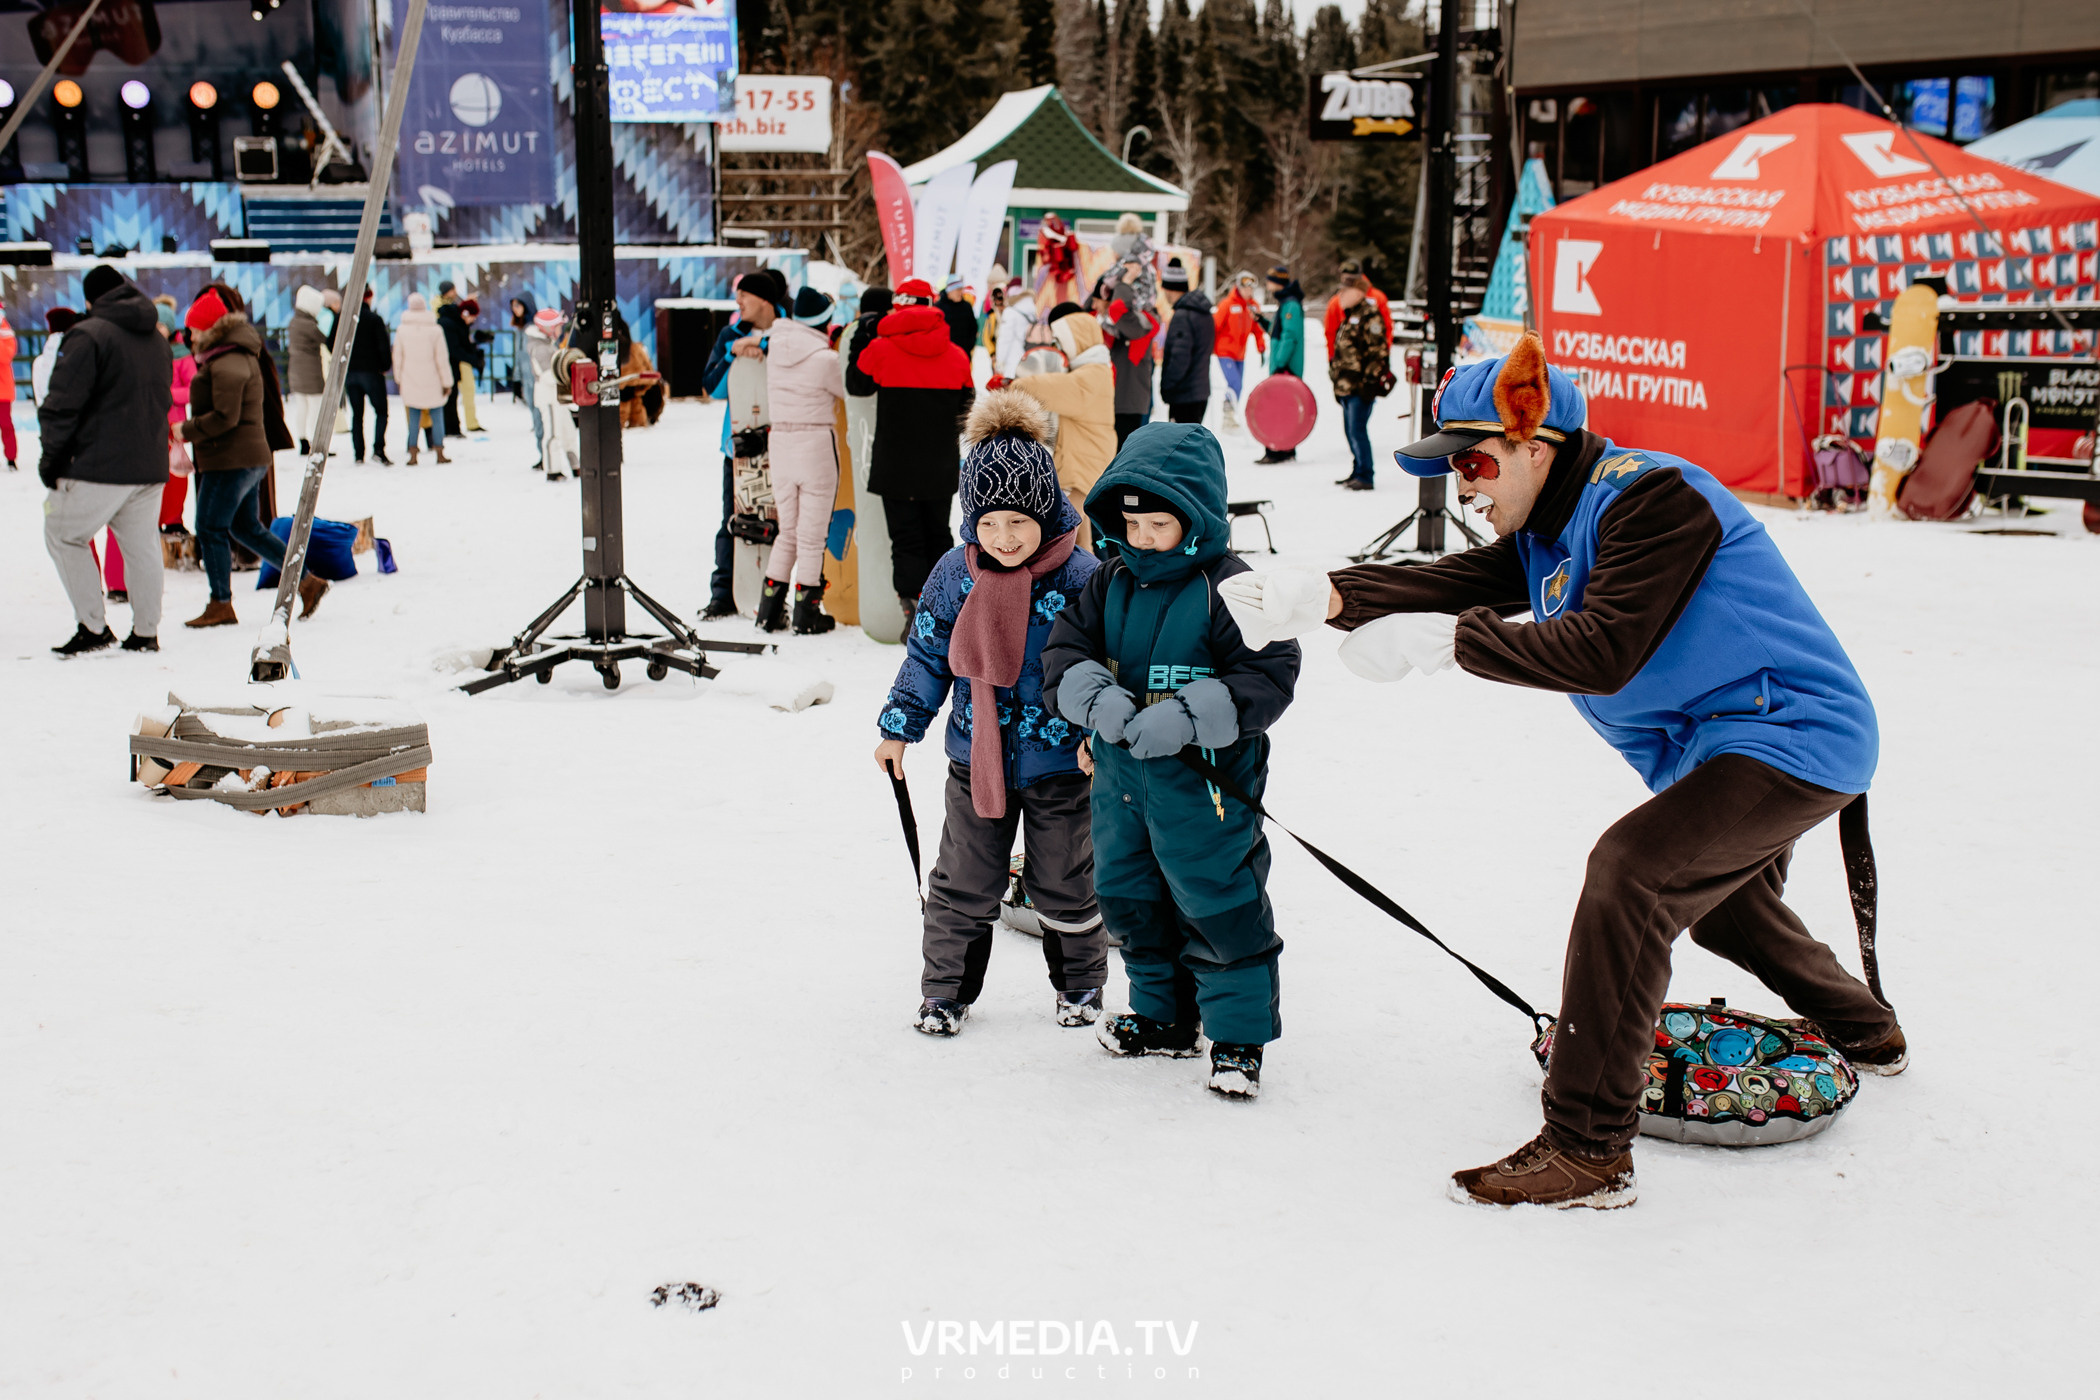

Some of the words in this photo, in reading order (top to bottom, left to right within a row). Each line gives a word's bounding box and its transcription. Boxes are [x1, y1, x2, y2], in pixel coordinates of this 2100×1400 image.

[1320, 74, 1417, 121] ZUBR
[452, 158, 507, 172] HOTELS
[1641, 182, 1787, 209] КУЗБАССКАЯ
[1845, 172, 2005, 209] КУЗБАССКАЯ
[1608, 199, 1690, 220] МЕДИА
[1684, 204, 1773, 229] ГРУППА
[1553, 328, 1687, 370] КУЗБАССКАЯ
[1626, 372, 1710, 411] ГРУППА
[1148, 664, 1217, 690] BES
